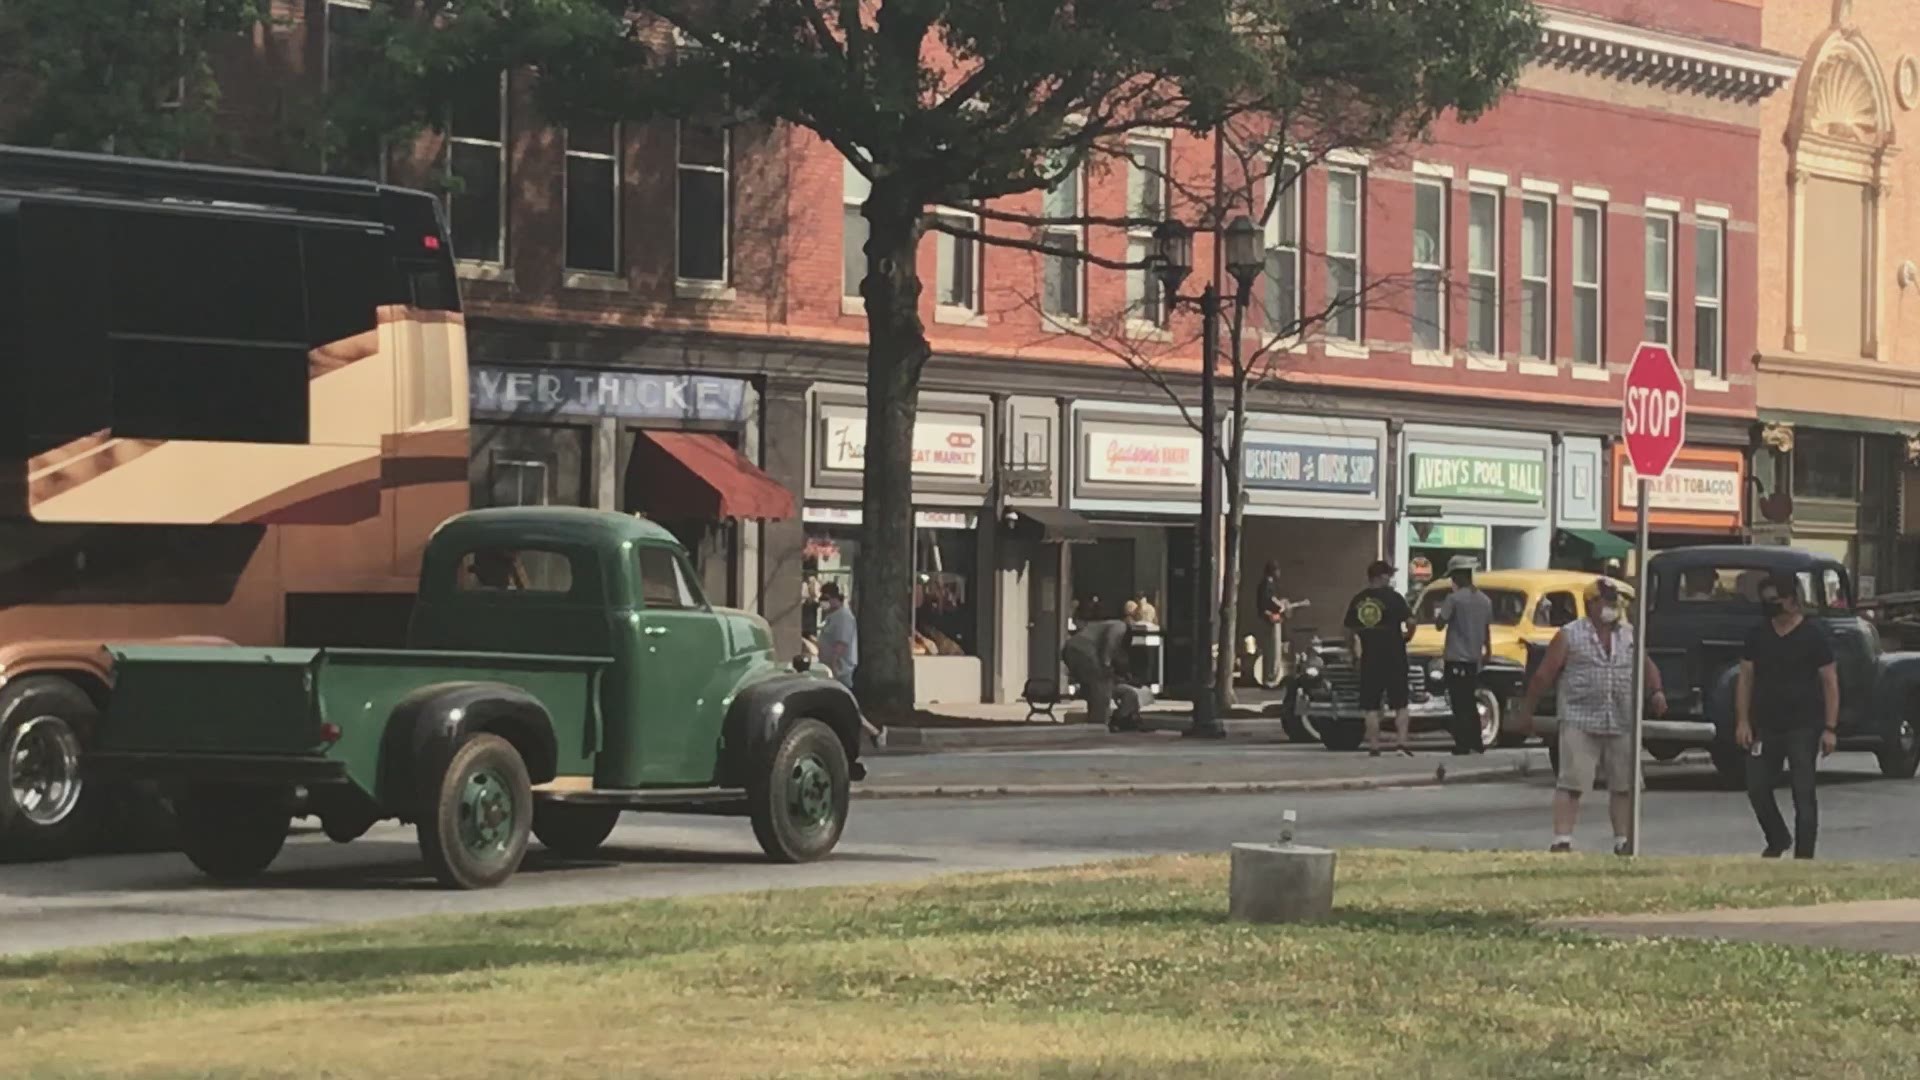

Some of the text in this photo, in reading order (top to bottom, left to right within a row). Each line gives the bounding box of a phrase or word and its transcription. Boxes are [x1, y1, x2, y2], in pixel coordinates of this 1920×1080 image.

[470, 370, 743, 410] VER THICKET
[1626, 385, 1680, 437] STOP
[911, 449, 977, 465] EAT MARKET
[1351, 455, 1375, 484] SHOP
[1417, 457, 1543, 496] AVERY'S POOL HALL
[1683, 478, 1733, 497] TOBACCO
